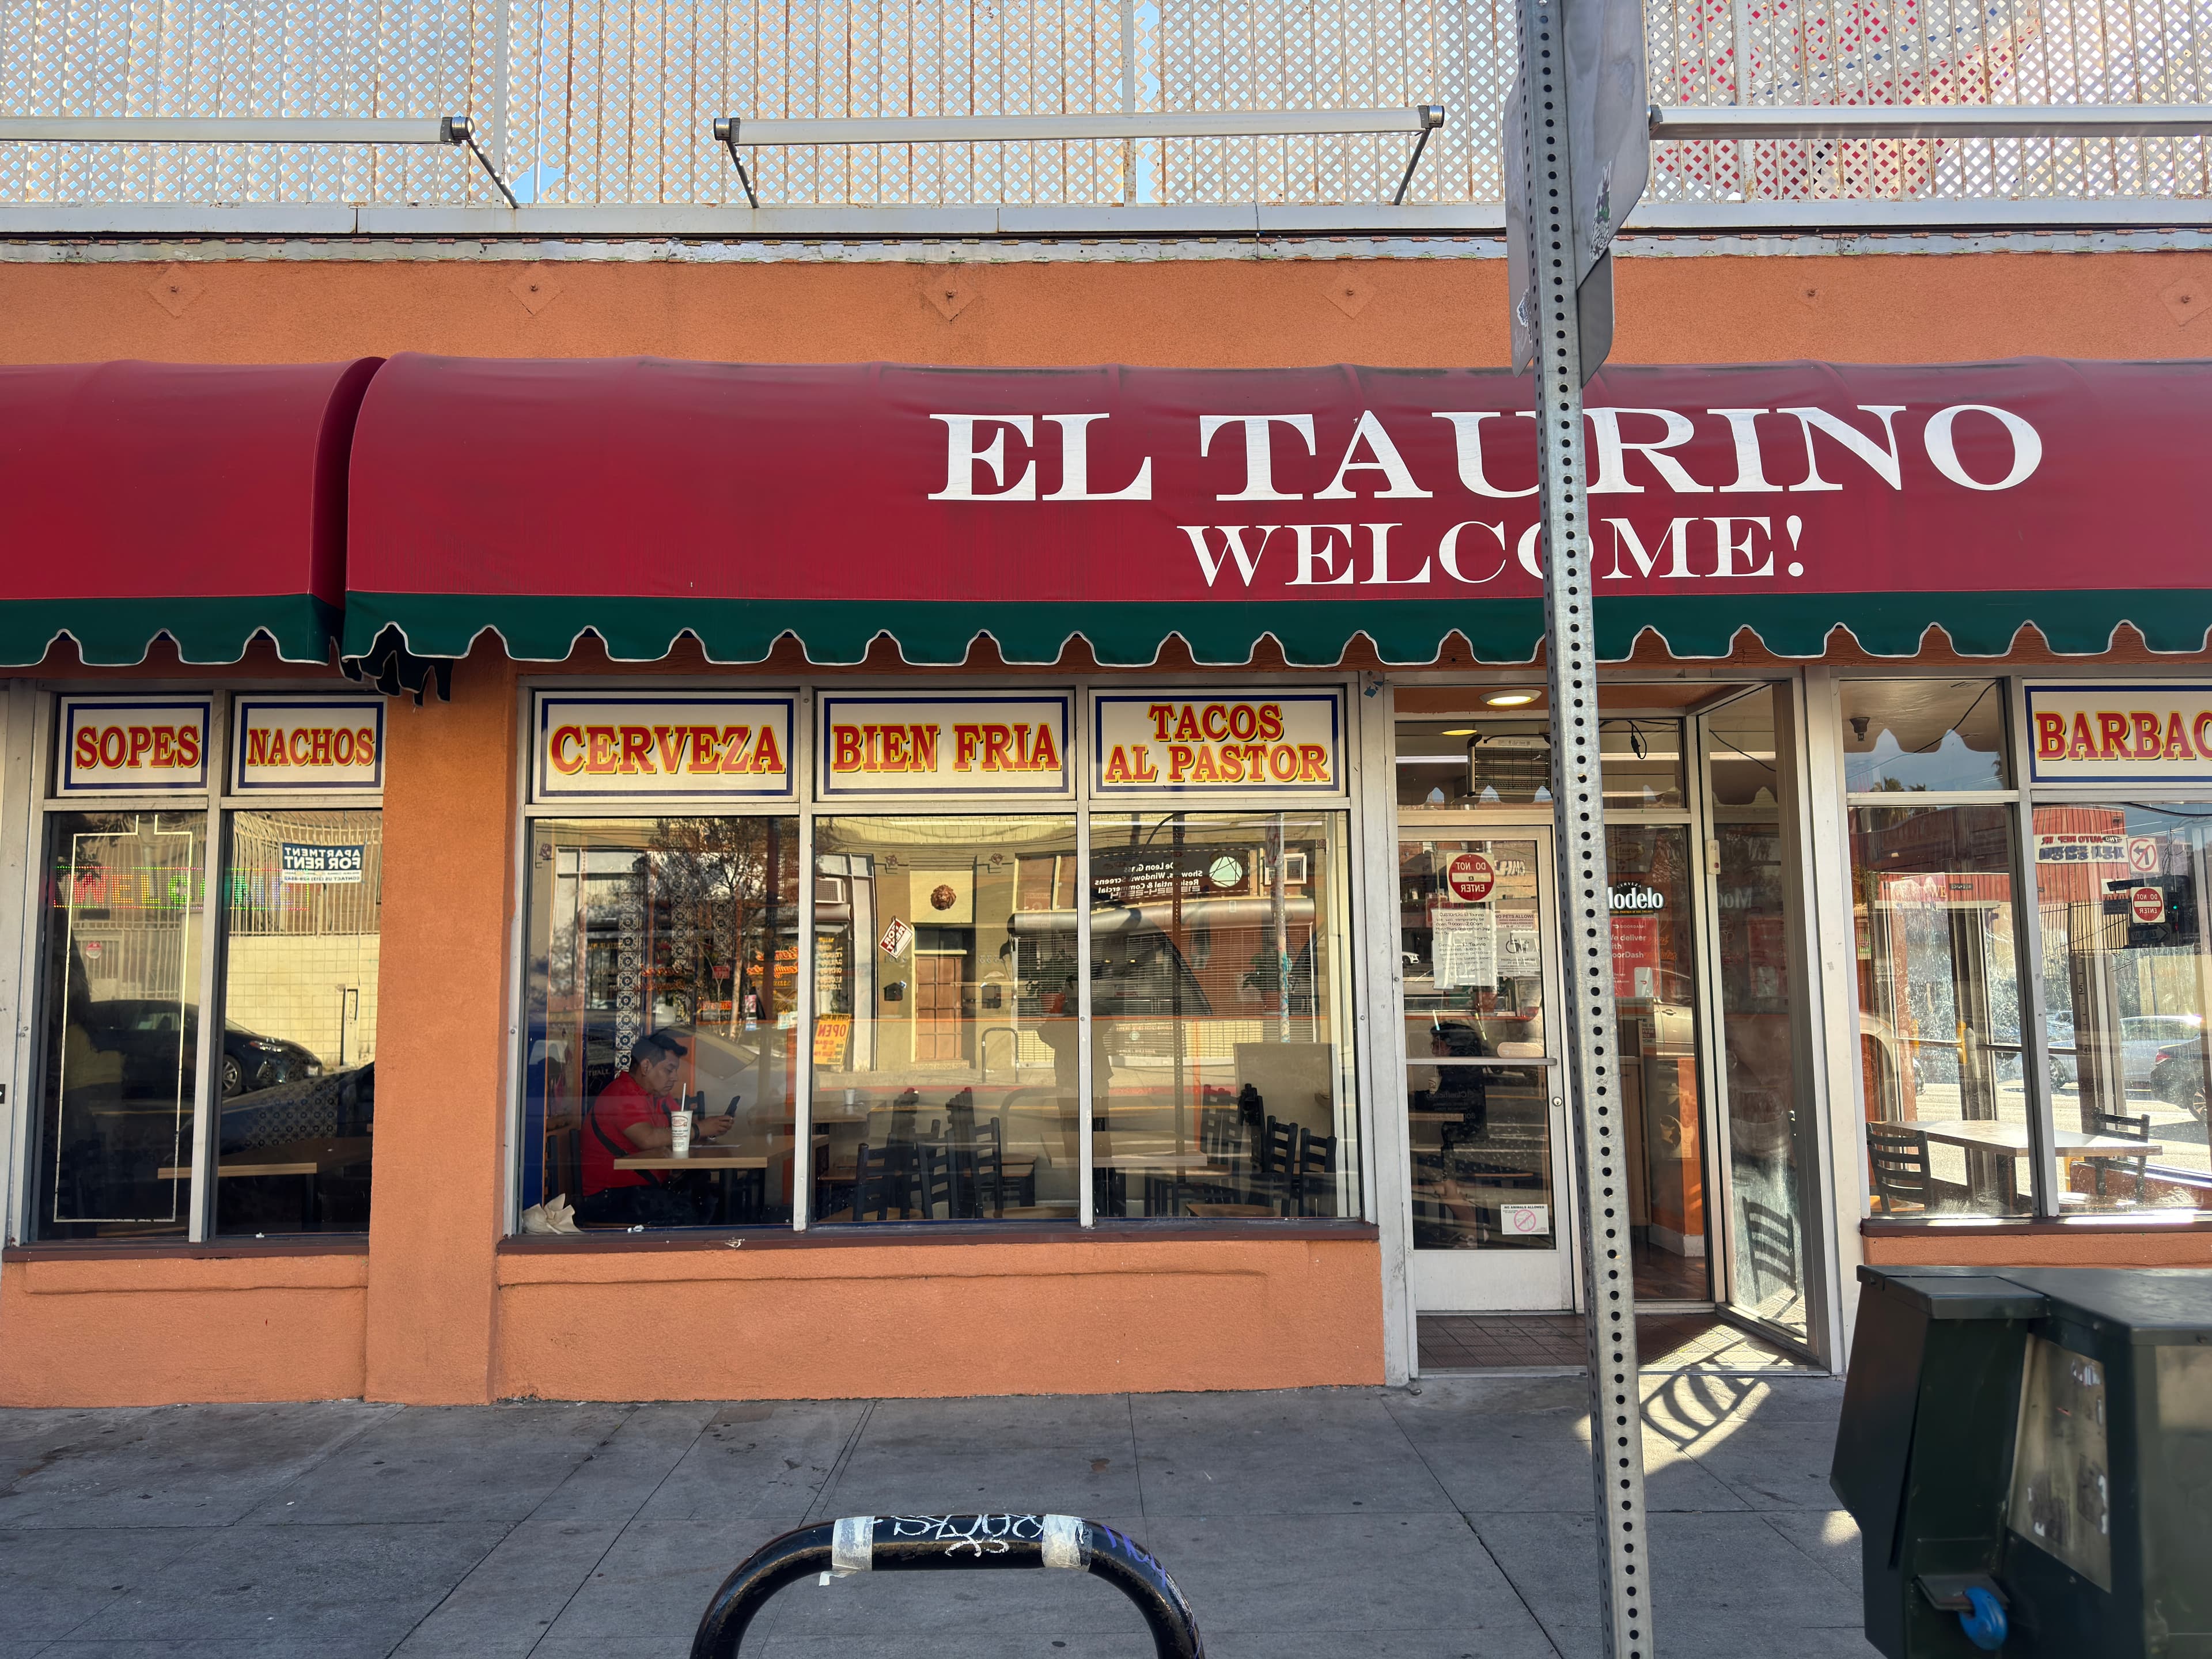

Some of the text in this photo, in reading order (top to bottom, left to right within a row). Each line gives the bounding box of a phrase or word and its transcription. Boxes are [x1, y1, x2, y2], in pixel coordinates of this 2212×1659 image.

[927, 404, 2042, 502] EL TAURINO
[1147, 703, 1283, 743] TACOS
[75, 724, 201, 769] SOPES
[247, 727, 376, 767] NACHOS
[549, 724, 786, 775] CERVEZA
[832, 723, 1062, 772] BIEN FRIA
[1105, 744, 1331, 783] AL PASTOR
[69, 874, 294, 906] WELCME
[1608, 887, 1664, 910] odelo
